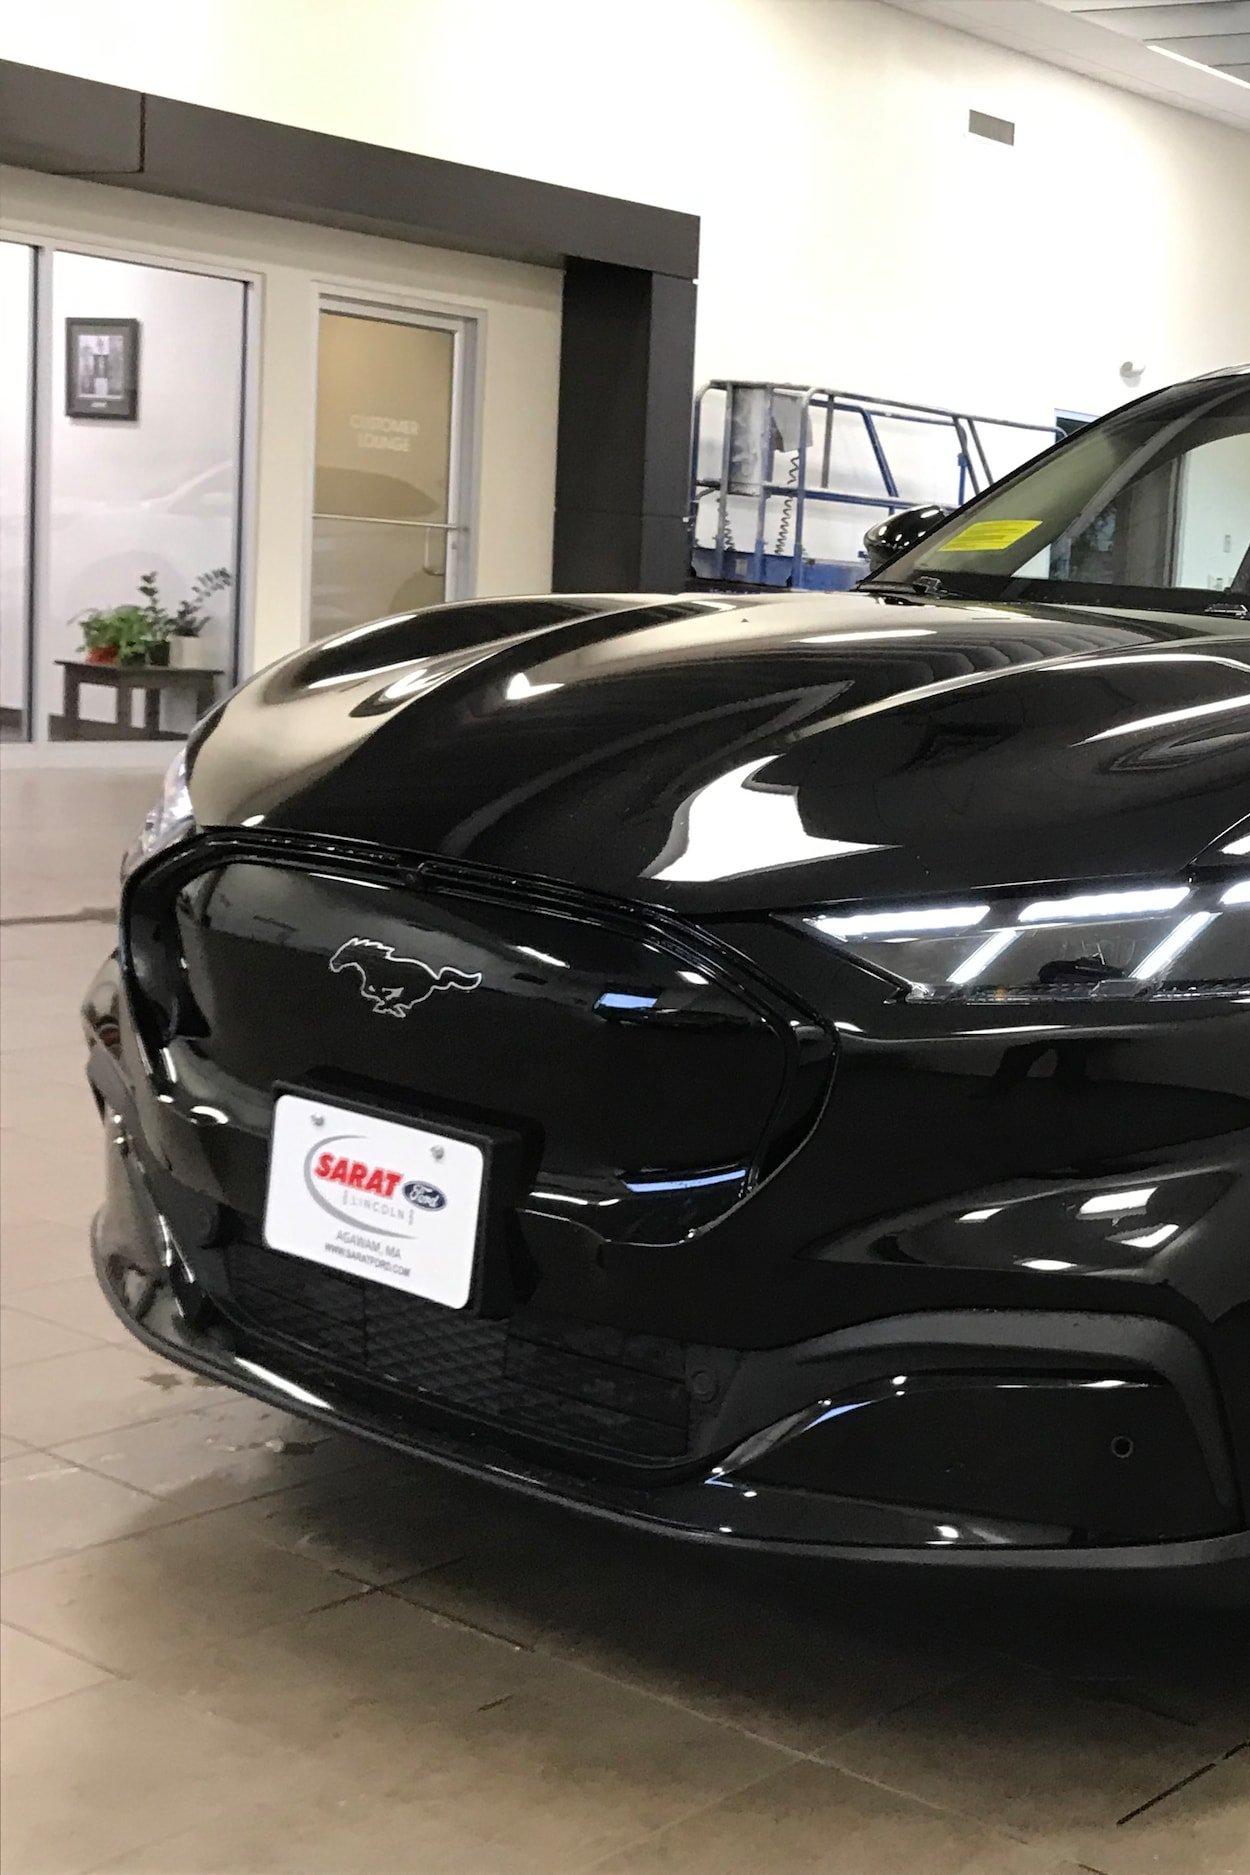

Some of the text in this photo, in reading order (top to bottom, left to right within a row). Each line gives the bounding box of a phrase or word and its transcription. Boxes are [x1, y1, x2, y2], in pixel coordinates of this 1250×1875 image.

[349, 414, 419, 435] CUSTOMER
[357, 433, 410, 453] LOUNGE
[314, 1152, 404, 1198] SARAT
[350, 1195, 405, 1220] LINCOLN
[407, 1183, 445, 1209] Ford
[385, 1244, 402, 1259] MA
